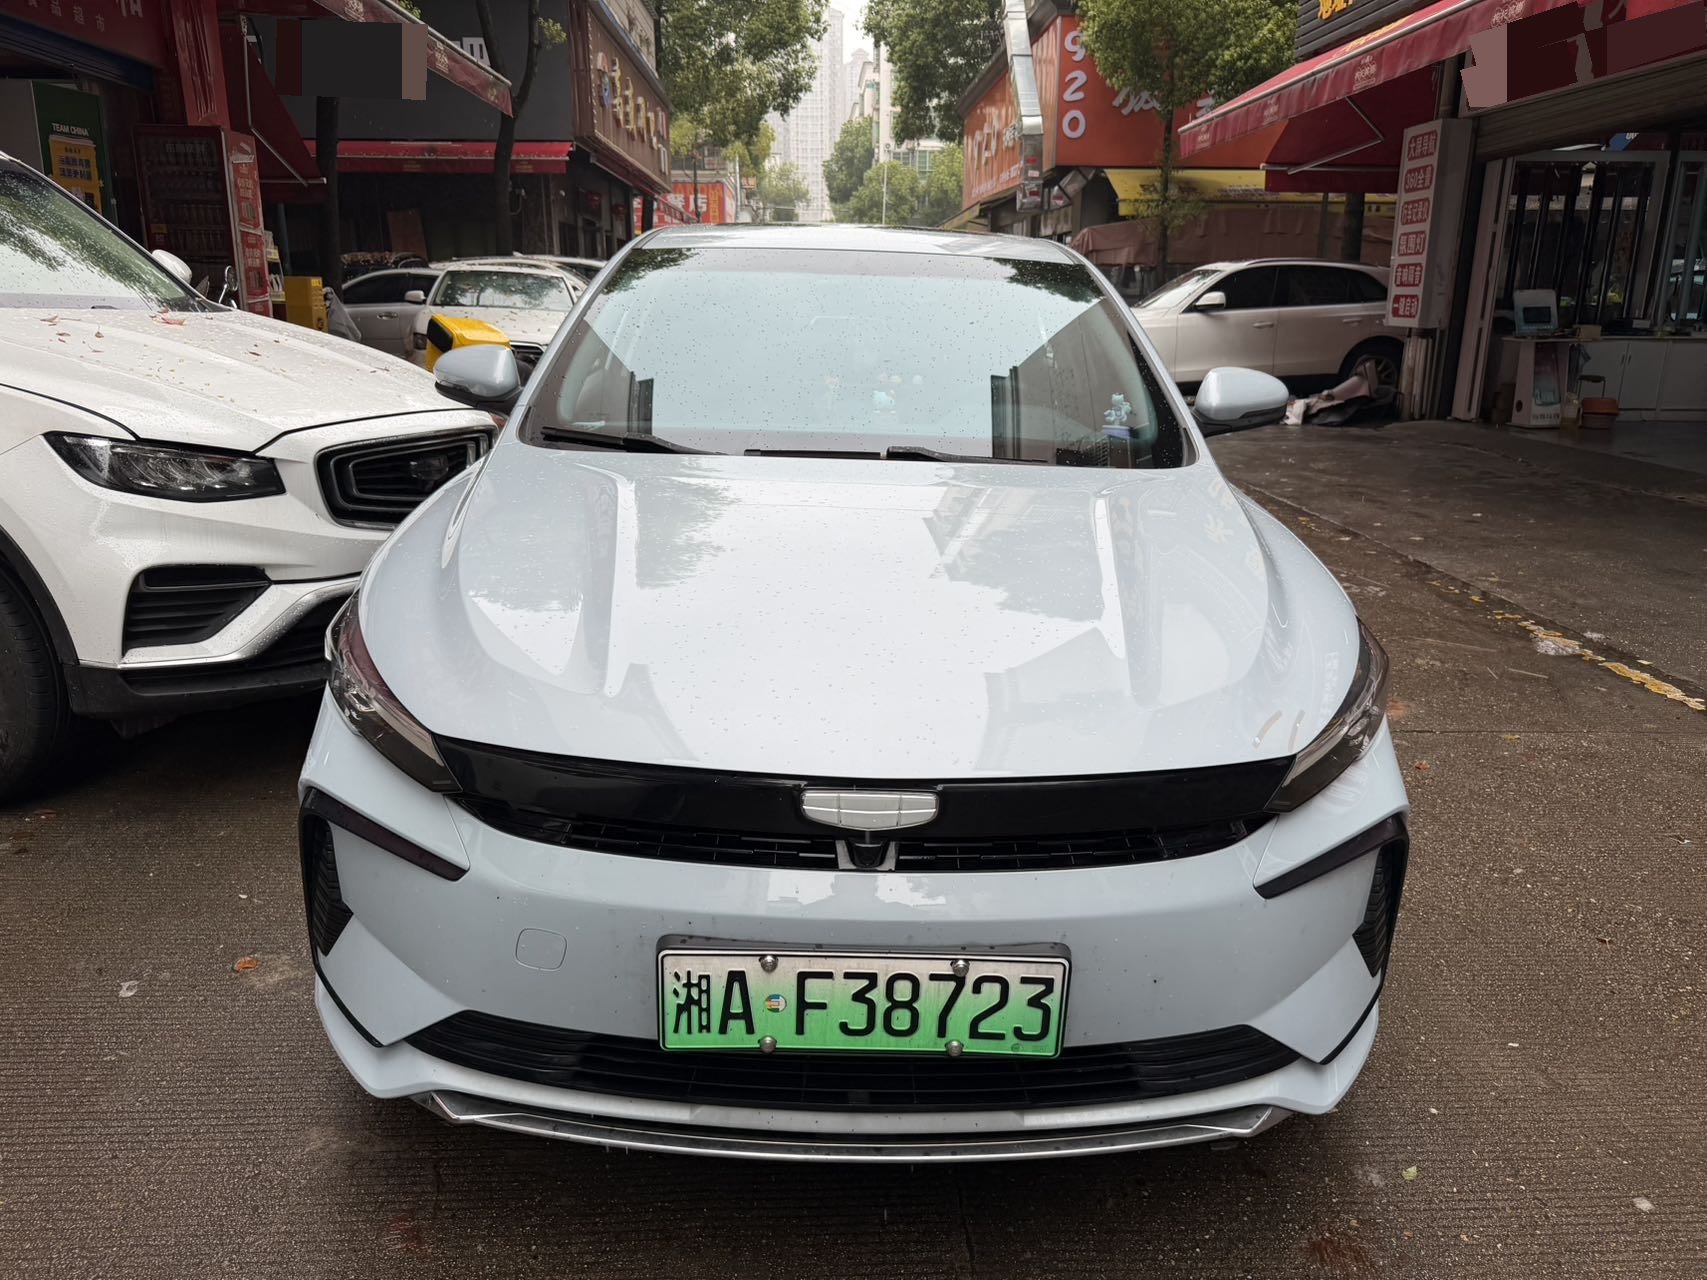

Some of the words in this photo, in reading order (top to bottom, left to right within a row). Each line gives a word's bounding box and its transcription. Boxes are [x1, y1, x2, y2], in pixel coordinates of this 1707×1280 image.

[51, 123, 69, 133] TEAM
[70, 126, 90, 137] CHINA
[1405, 166, 1432, 190] 360全景
[1393, 296, 1418, 317] 一键启动
